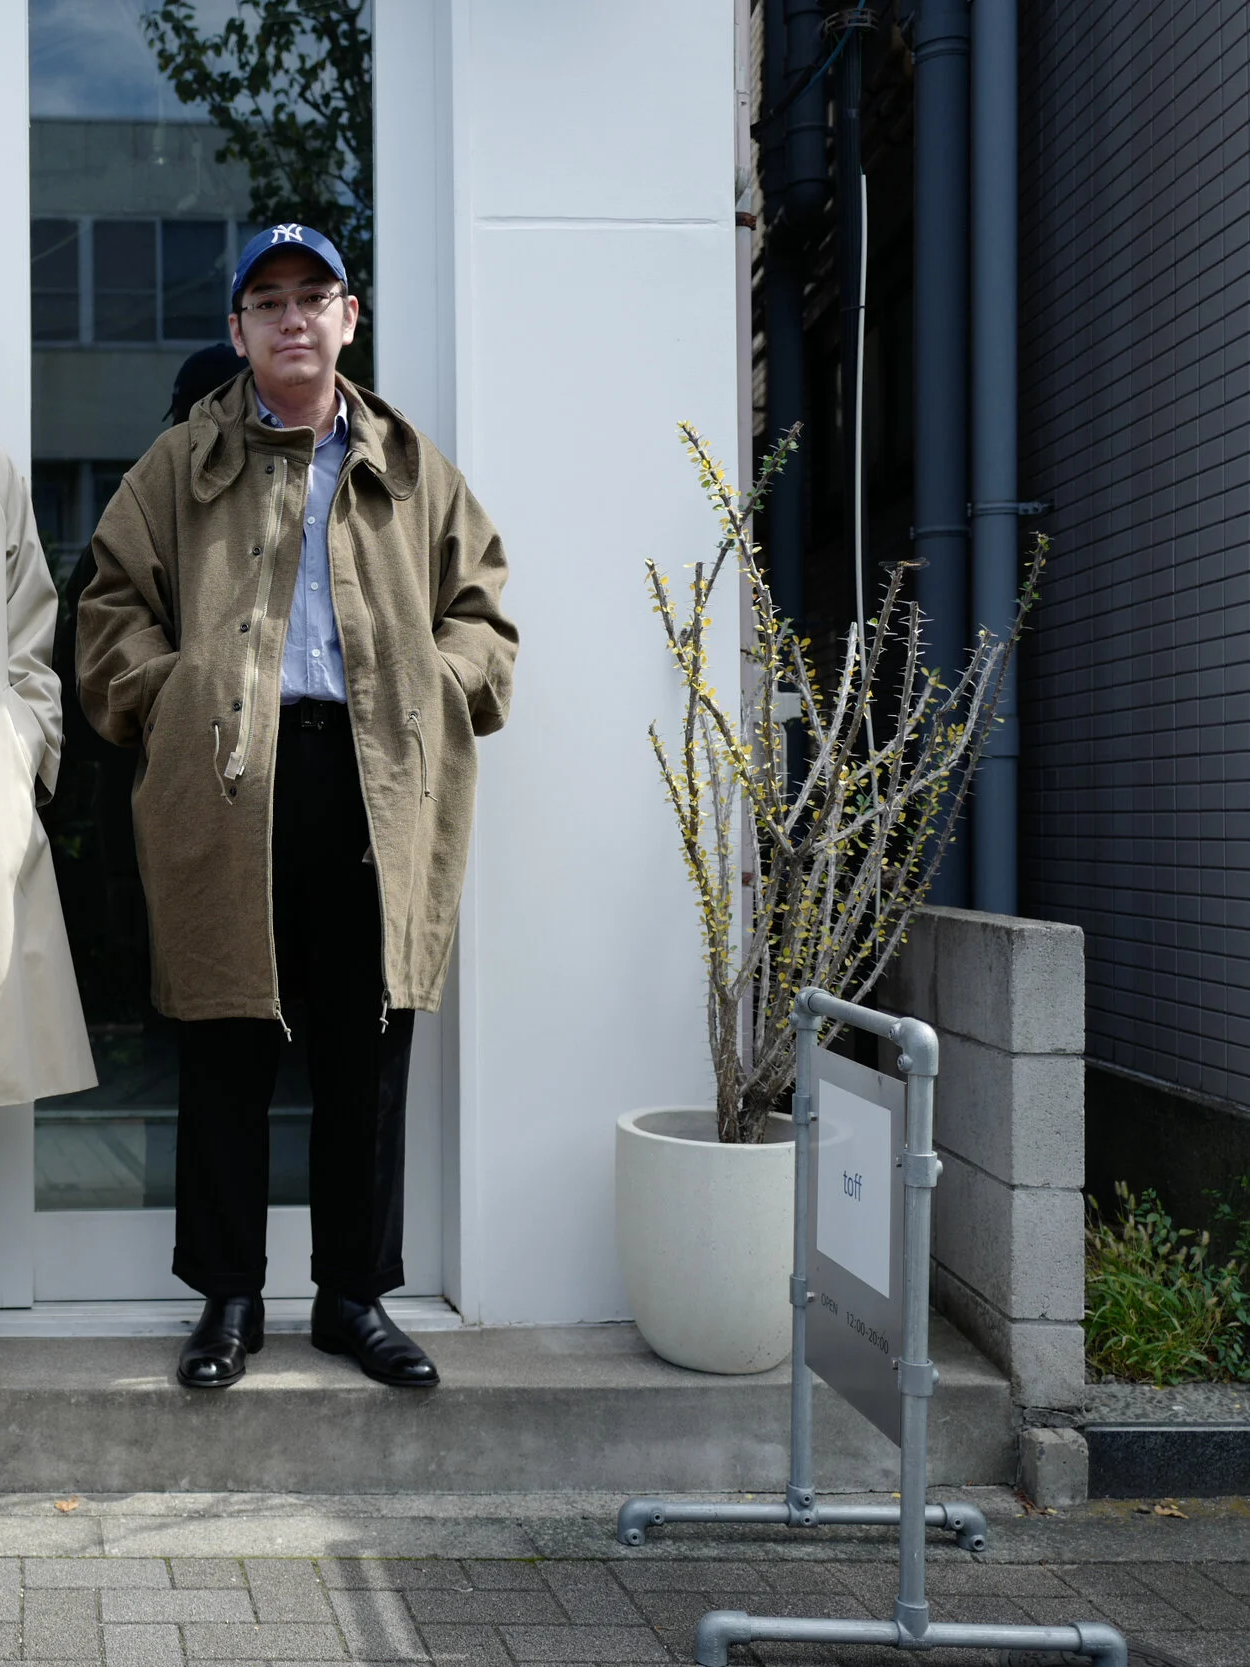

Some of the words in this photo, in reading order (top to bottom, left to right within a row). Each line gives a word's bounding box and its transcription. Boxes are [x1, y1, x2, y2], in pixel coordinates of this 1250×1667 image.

[271, 223, 302, 243] NY
[843, 1170, 862, 1201] toff
[821, 1292, 838, 1316] OPEN
[846, 1311, 889, 1354] 12:00-20:00
